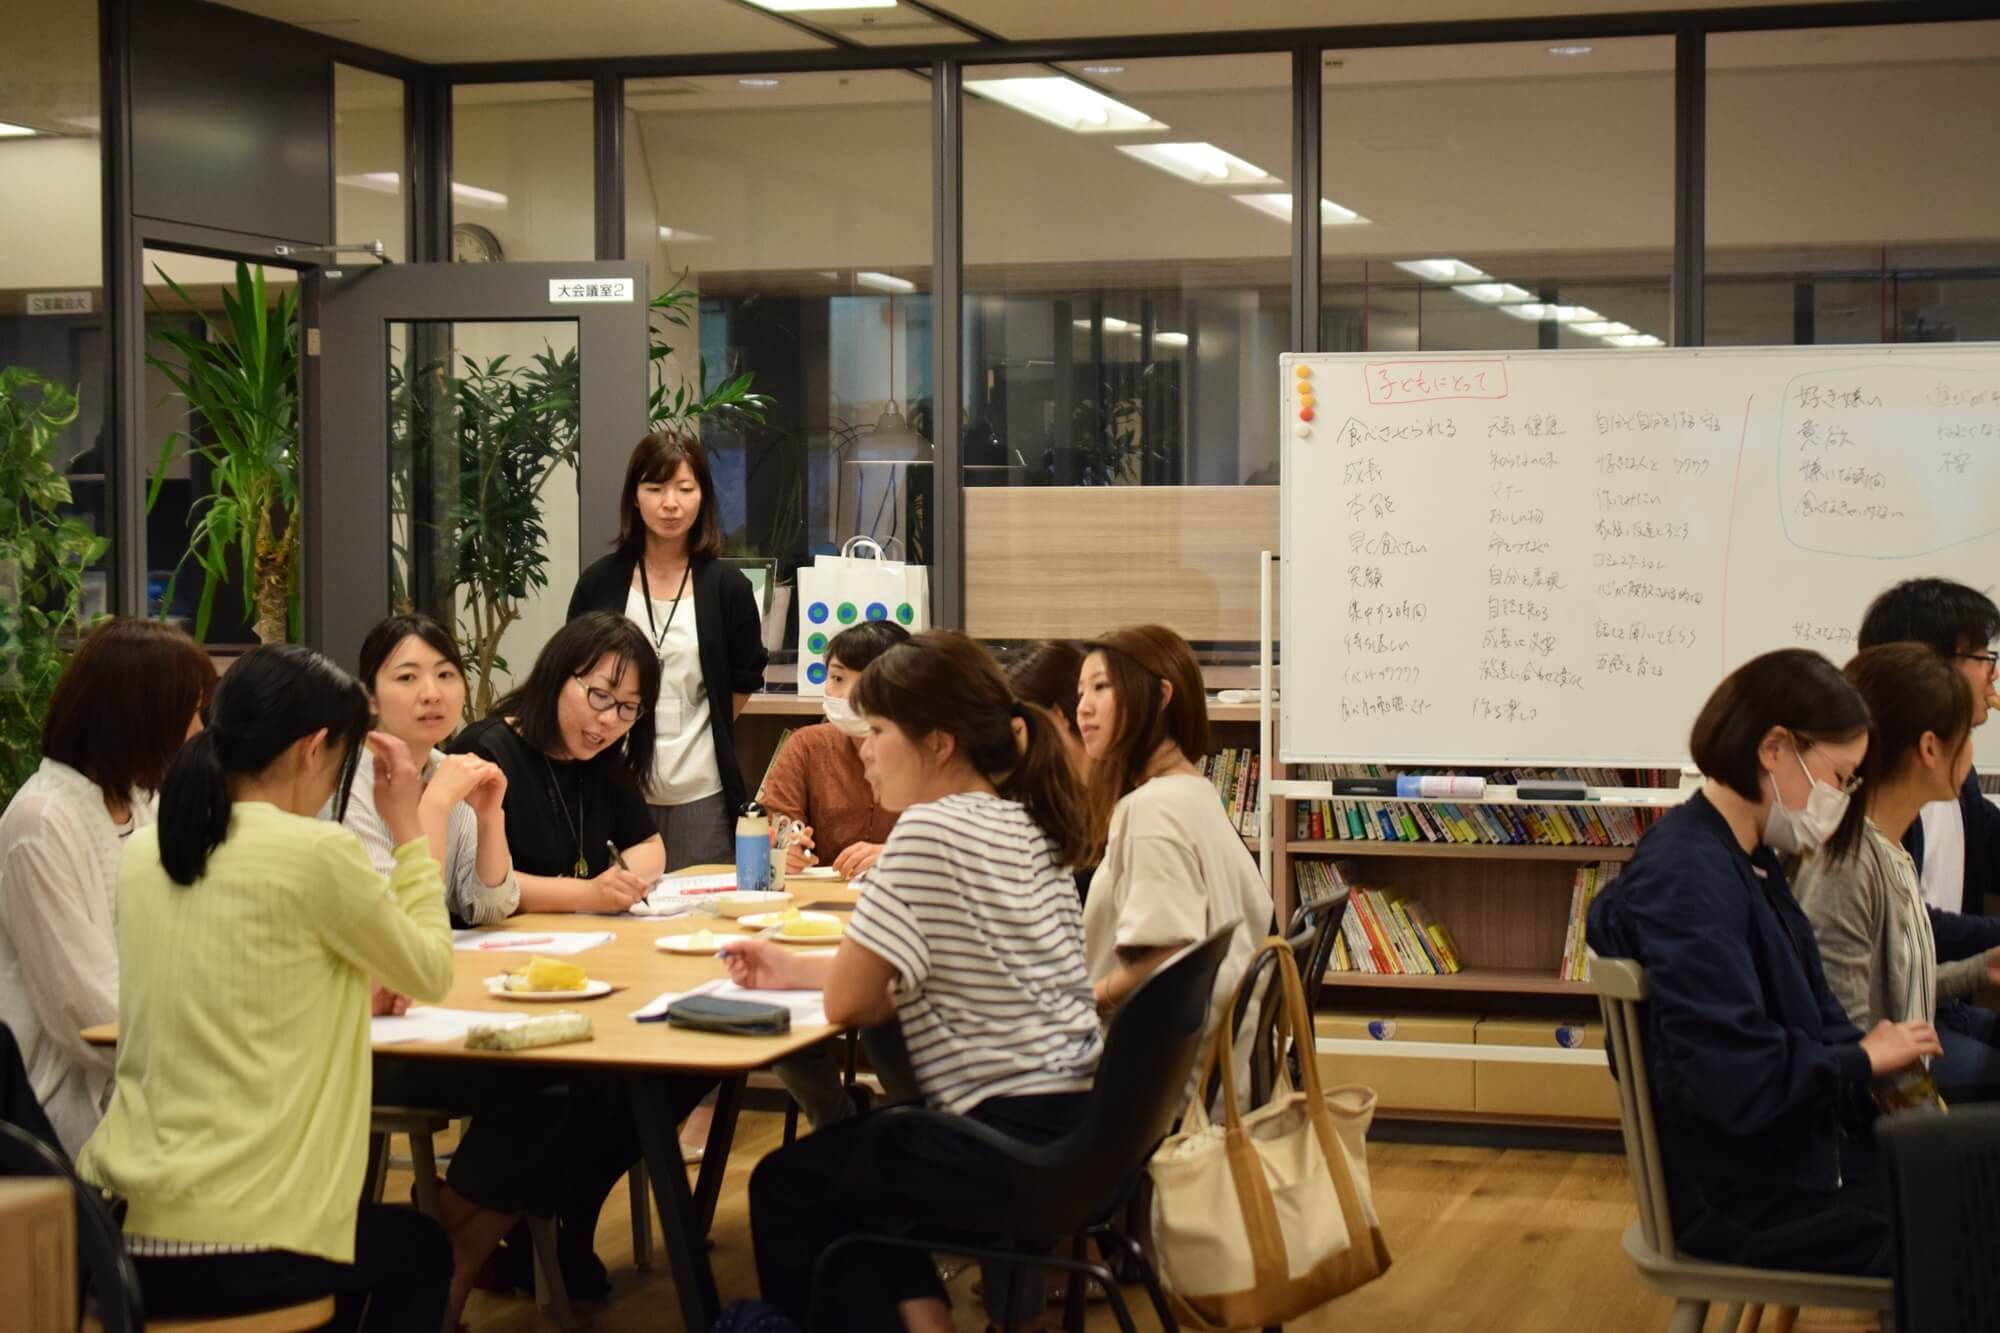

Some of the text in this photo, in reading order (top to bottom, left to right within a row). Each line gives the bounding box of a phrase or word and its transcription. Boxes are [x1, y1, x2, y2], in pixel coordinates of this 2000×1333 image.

[558, 283, 625, 298] 大会議室2
[1378, 369, 1488, 400] 子どもにとって
[1793, 384, 1883, 409] 好き嫌い
[1336, 416, 1457, 448] 食べさせられる
[1344, 457, 1383, 486] 成長
[1349, 531, 1428, 556] 早く食べたい
